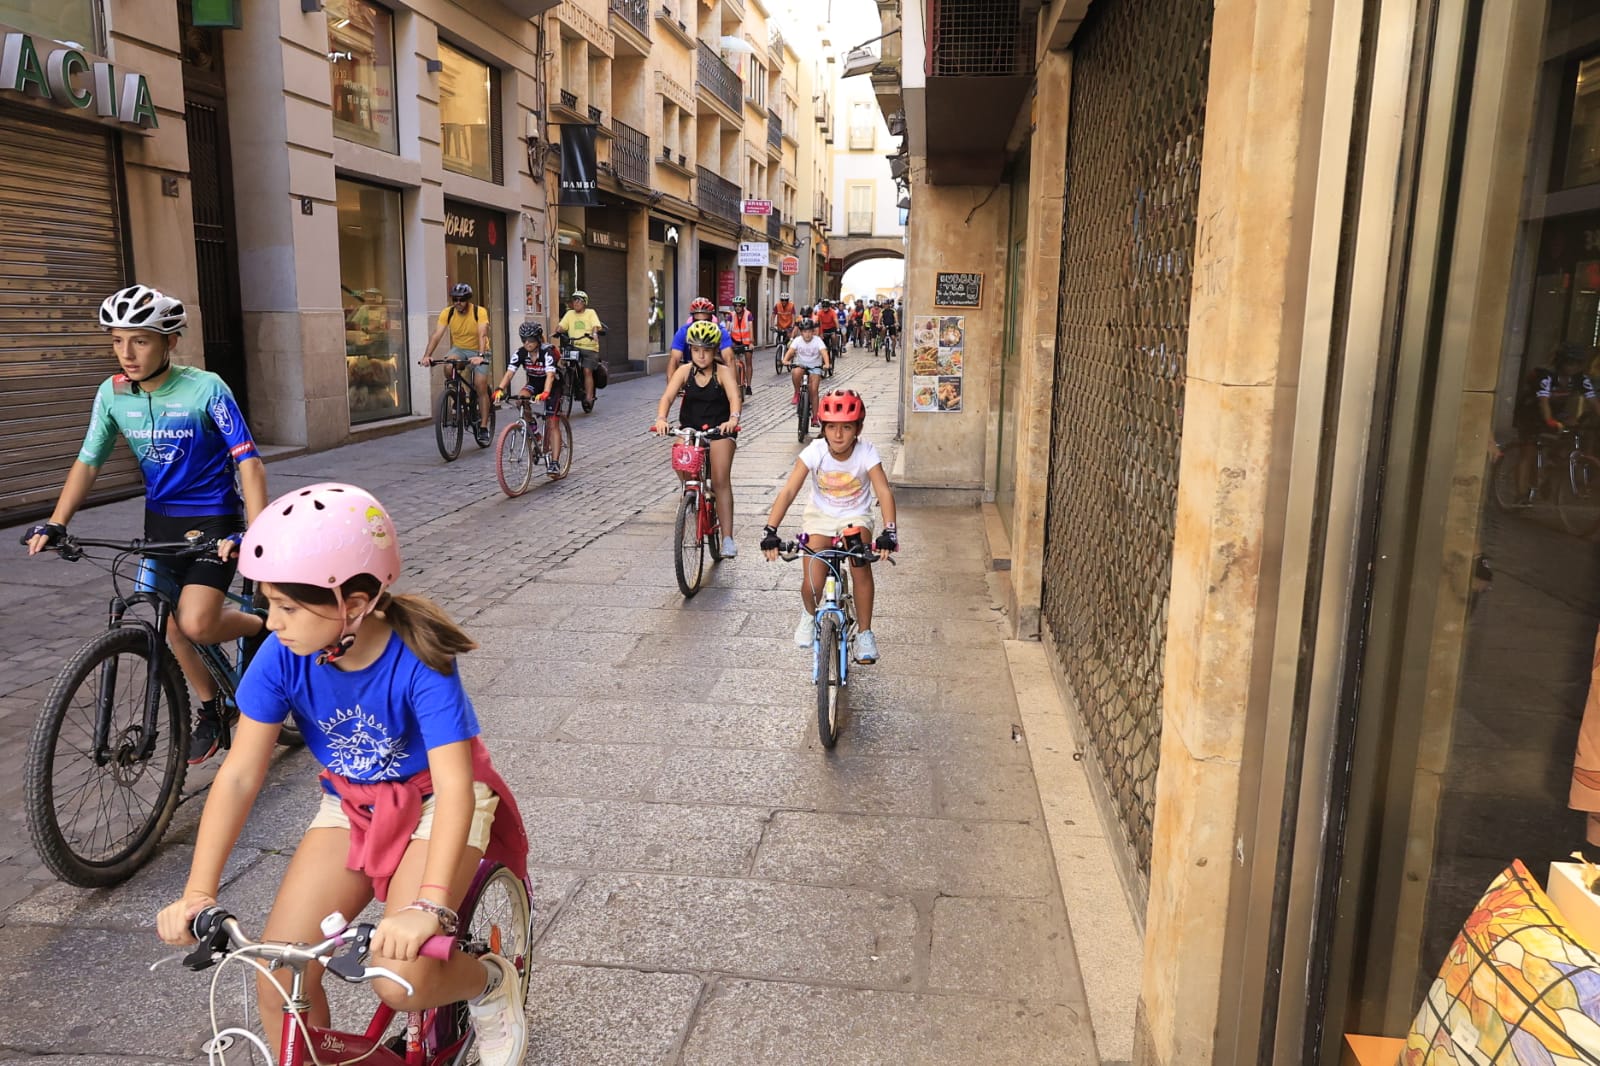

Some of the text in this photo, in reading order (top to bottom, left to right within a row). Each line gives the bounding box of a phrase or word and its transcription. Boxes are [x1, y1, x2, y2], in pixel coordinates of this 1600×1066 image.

[1, 32, 160, 129] ACIA
[562, 180, 596, 189] BAMBÚ
[144, 446, 176, 461] Ford
